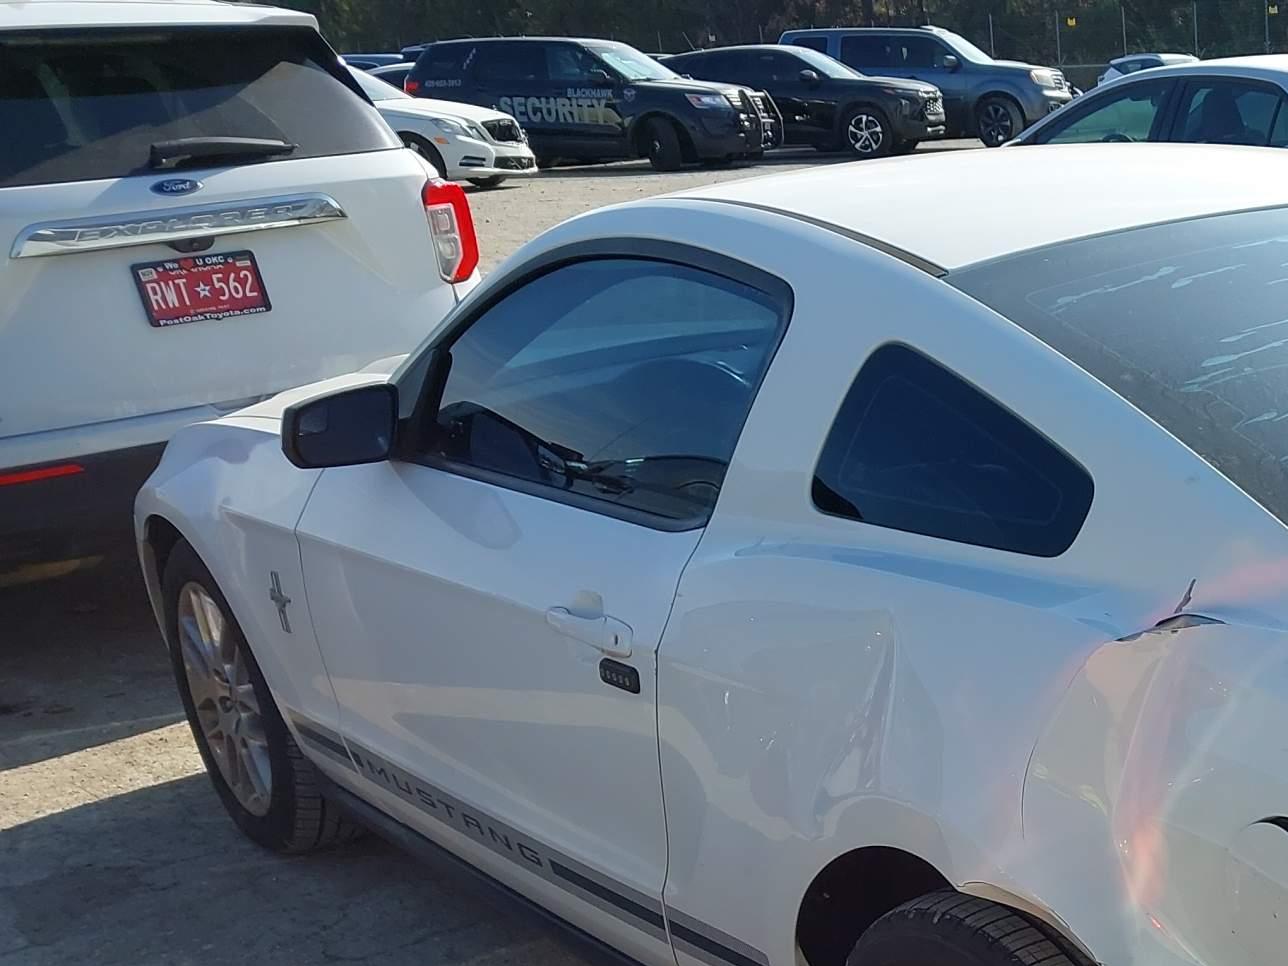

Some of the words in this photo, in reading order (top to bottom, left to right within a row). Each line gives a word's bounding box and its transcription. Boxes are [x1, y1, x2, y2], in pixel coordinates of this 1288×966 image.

[567, 88, 613, 98] BLACKHAWK
[499, 96, 607, 124] SECURITY
[162, 181, 190, 191] Ford
[74, 205, 294, 242] EXPLORER
[164, 262, 179, 270] We
[195, 258, 203, 266] U
[205, 256, 225, 265] OKC
[146, 279, 191, 311] RWT
[212, 271, 258, 300] 562
[159, 306, 267, 326] PostOakToyota.com
[366, 759, 544, 867] MUSTANG
